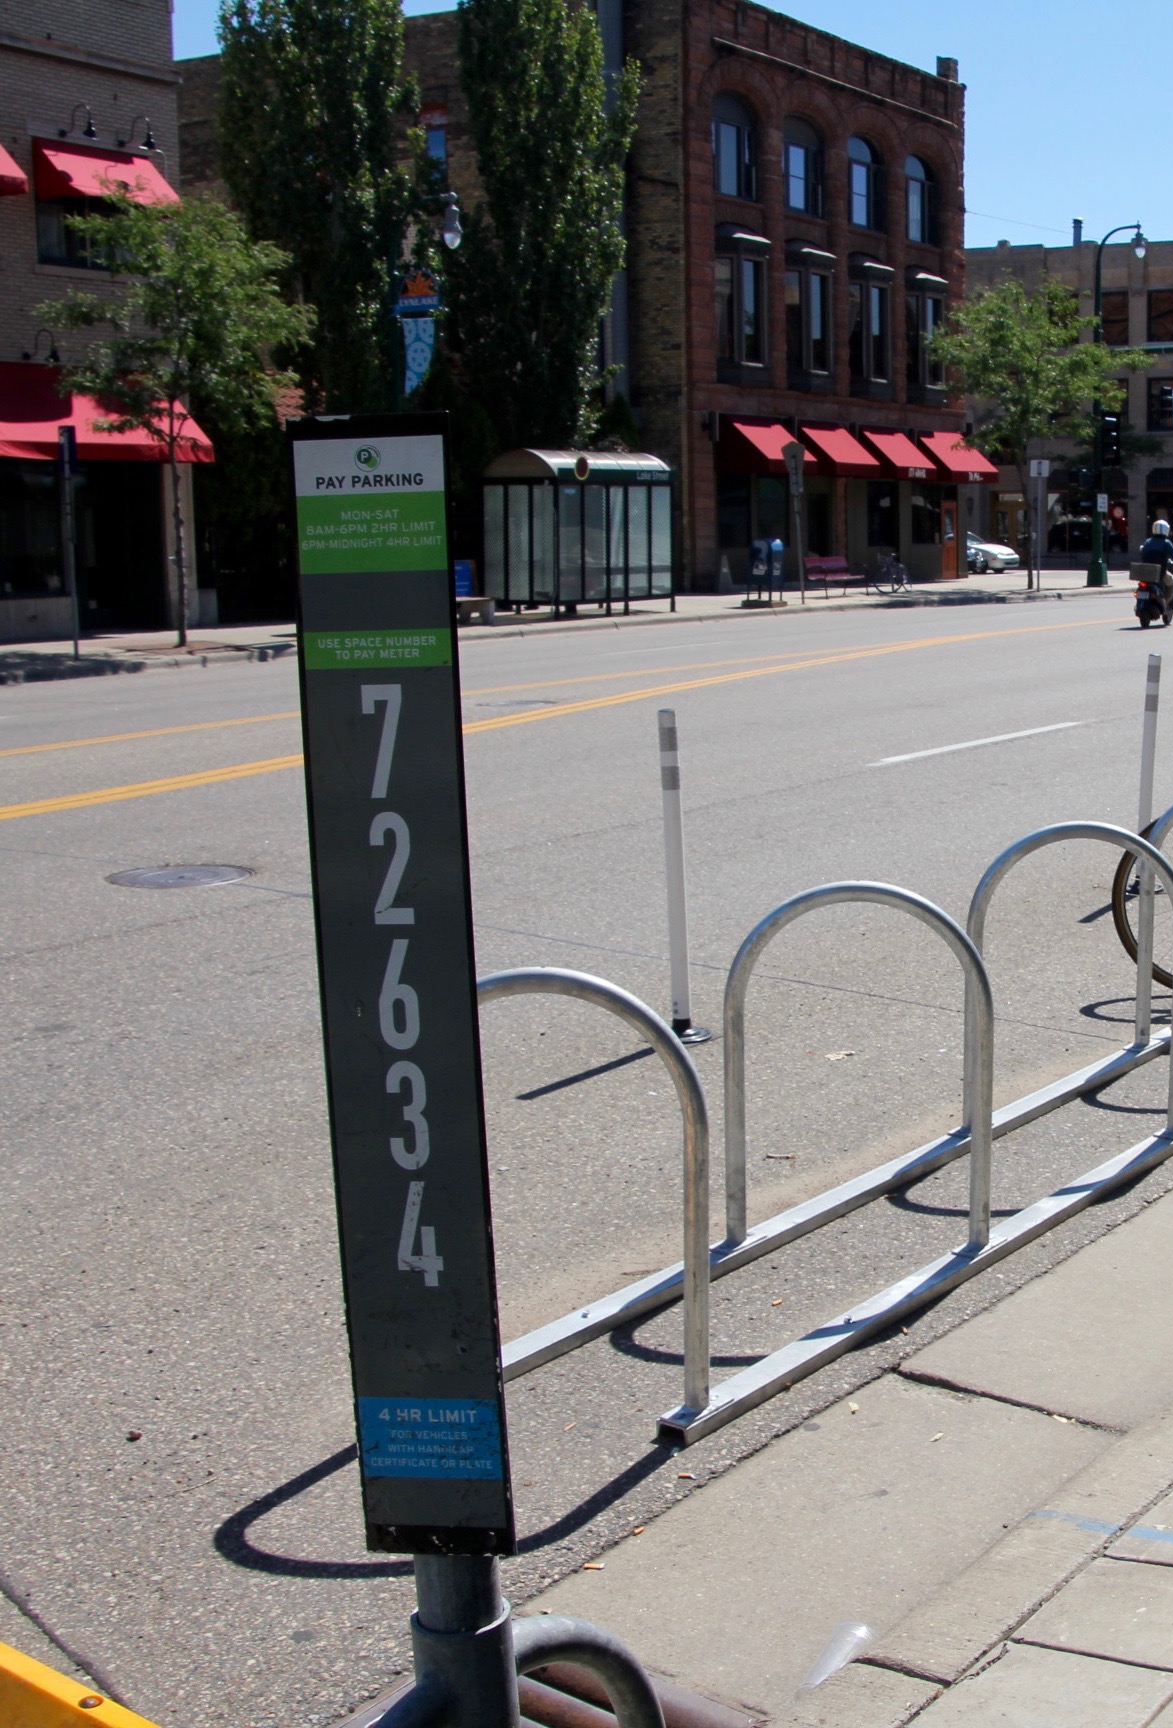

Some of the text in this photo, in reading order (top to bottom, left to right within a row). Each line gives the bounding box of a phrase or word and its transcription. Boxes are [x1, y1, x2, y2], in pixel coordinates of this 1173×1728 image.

[315, 473, 424, 489] PAY PARKING
[340, 509, 400, 520] MON-SAT
[306, 521, 436, 536] 8AM-6PM 2HR LIMIT
[301, 536, 443, 550] 6PM-MIDNIGHT 4HR LIMIT
[318, 635, 437, 649] USE SPACE NUMBER
[335, 648, 420, 660] TO PAY METER
[378, 1408, 477, 1423] 4 HR LIMIT
[391, 1430, 468, 1440] FOR VEHICLES
[387, 1444, 414, 1453] WITH
[370, 1457, 437, 1468] CERTIFICATE
[441, 1458, 456, 1468] OR
